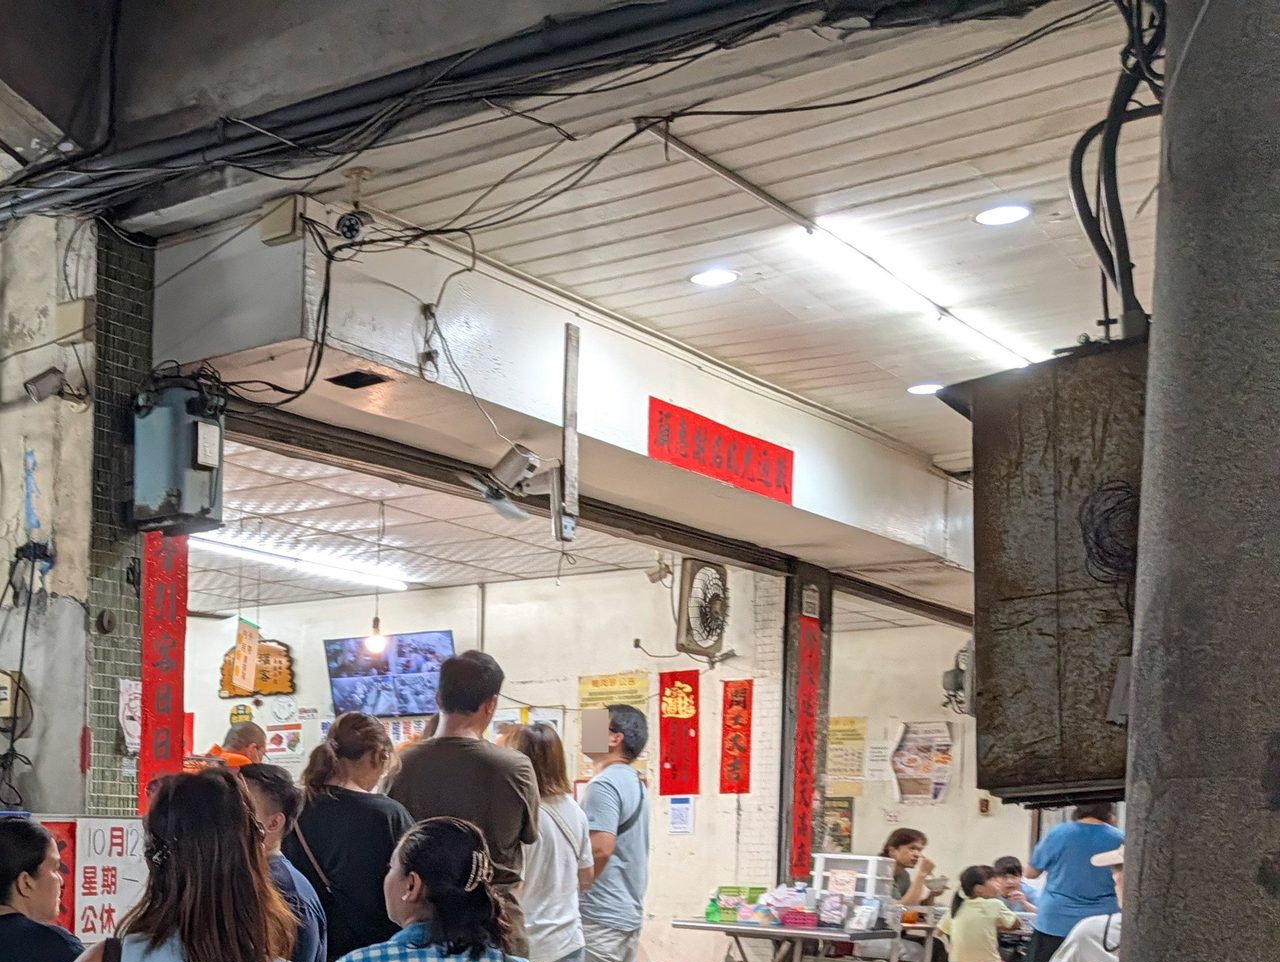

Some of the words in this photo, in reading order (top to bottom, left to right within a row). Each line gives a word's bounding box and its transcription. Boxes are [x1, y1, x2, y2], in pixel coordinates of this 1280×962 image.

[726, 688, 748, 782] 開工大吉
[81, 865, 139, 896] 星期一
[81, 903, 116, 934] 公休
